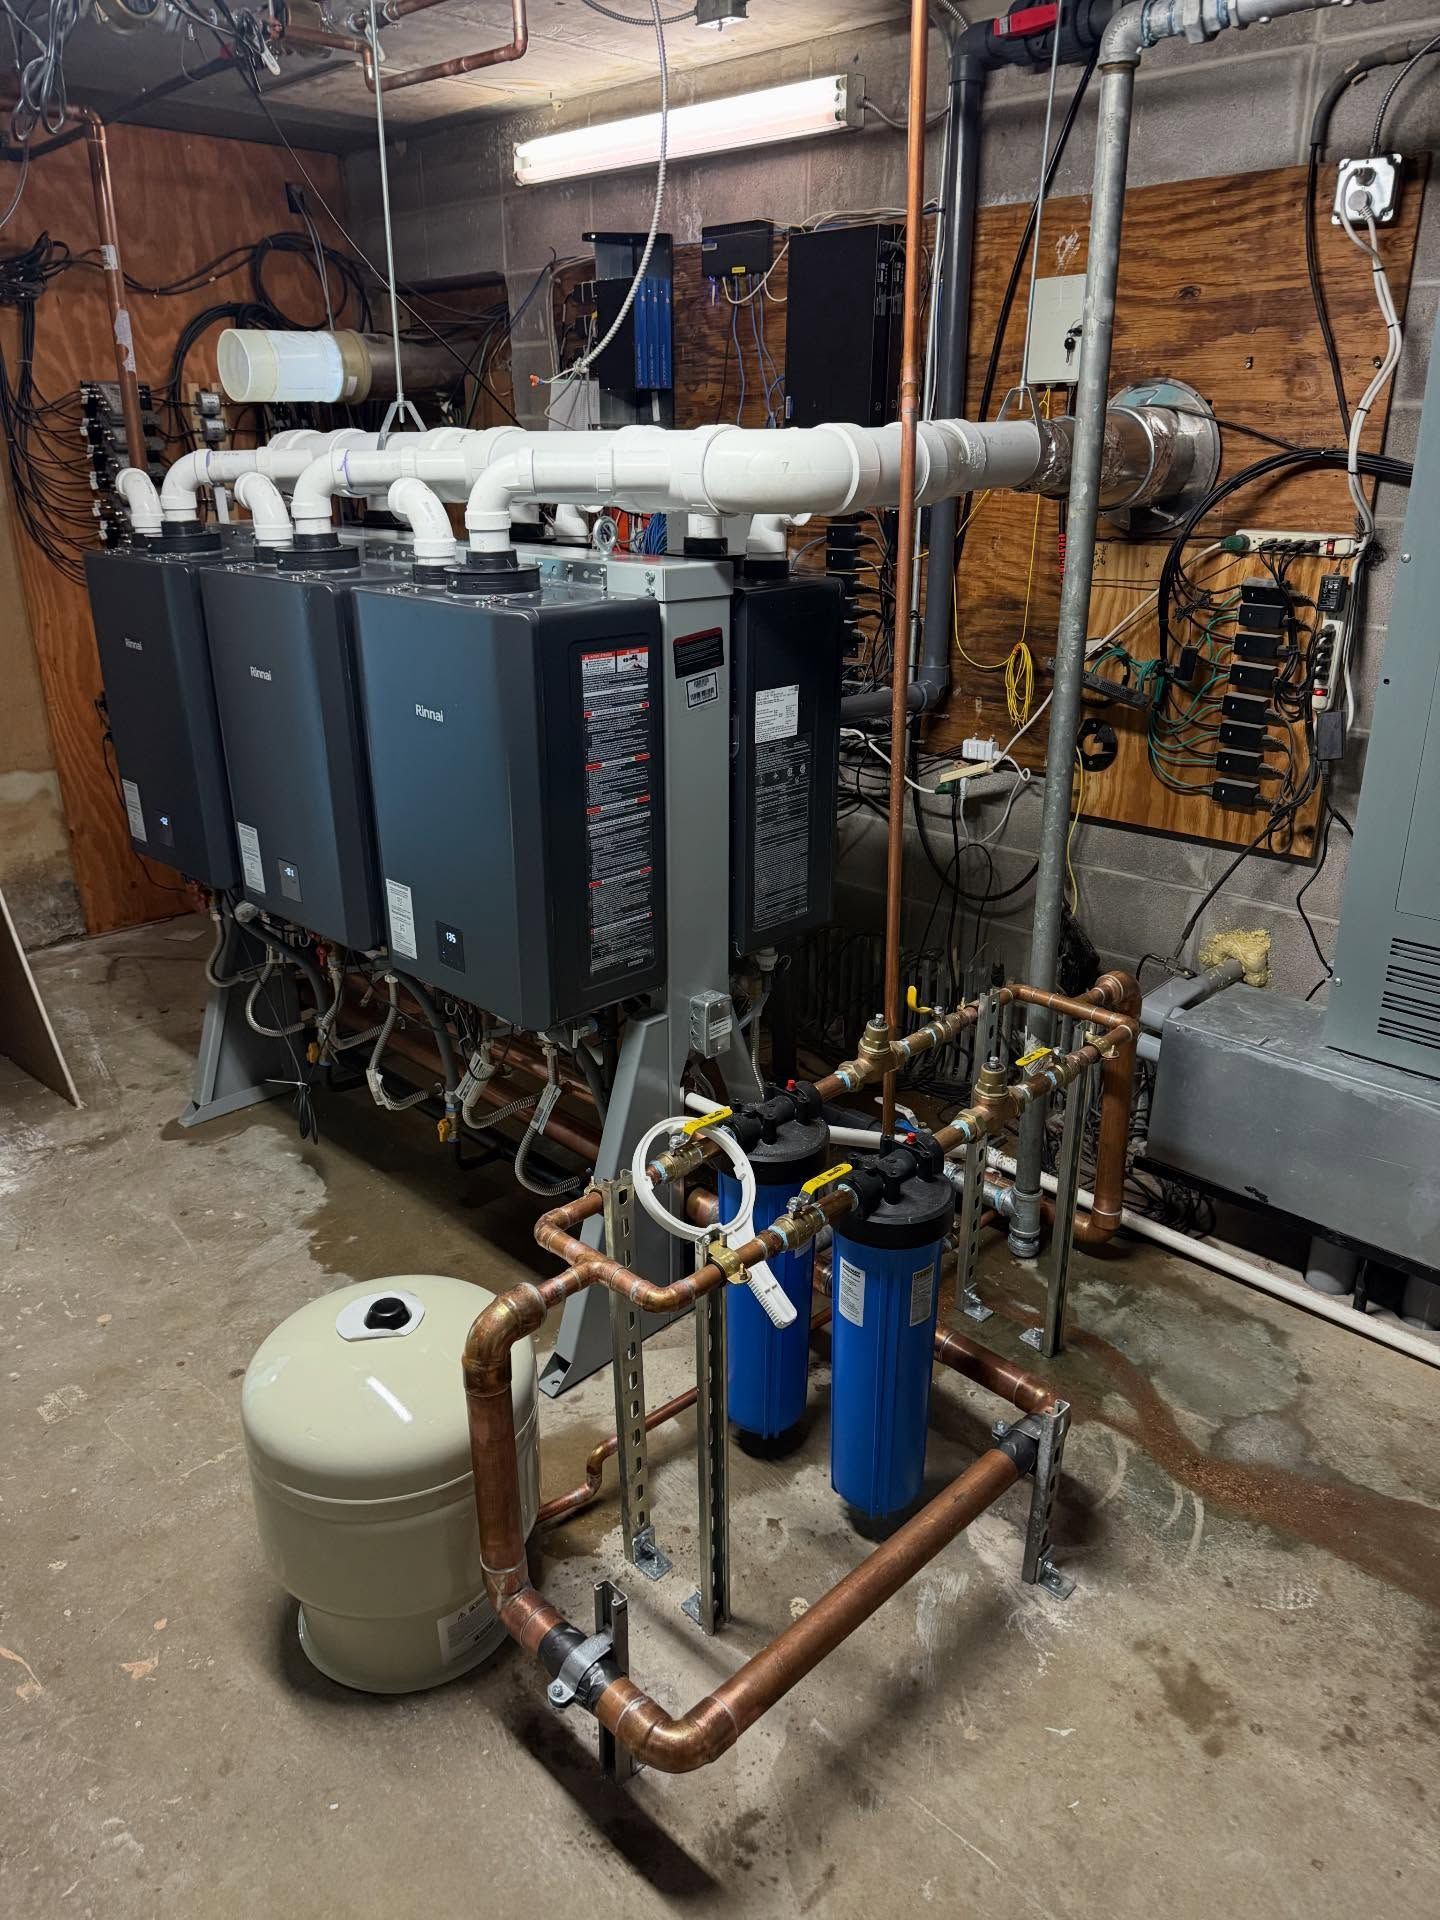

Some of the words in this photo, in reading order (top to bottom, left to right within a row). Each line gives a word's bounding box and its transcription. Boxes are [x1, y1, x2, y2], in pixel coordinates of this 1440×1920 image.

[124, 637, 143, 651] Rinnai
[250, 666, 272, 681] Rinnai
[415, 703, 444, 723] Rinnai
